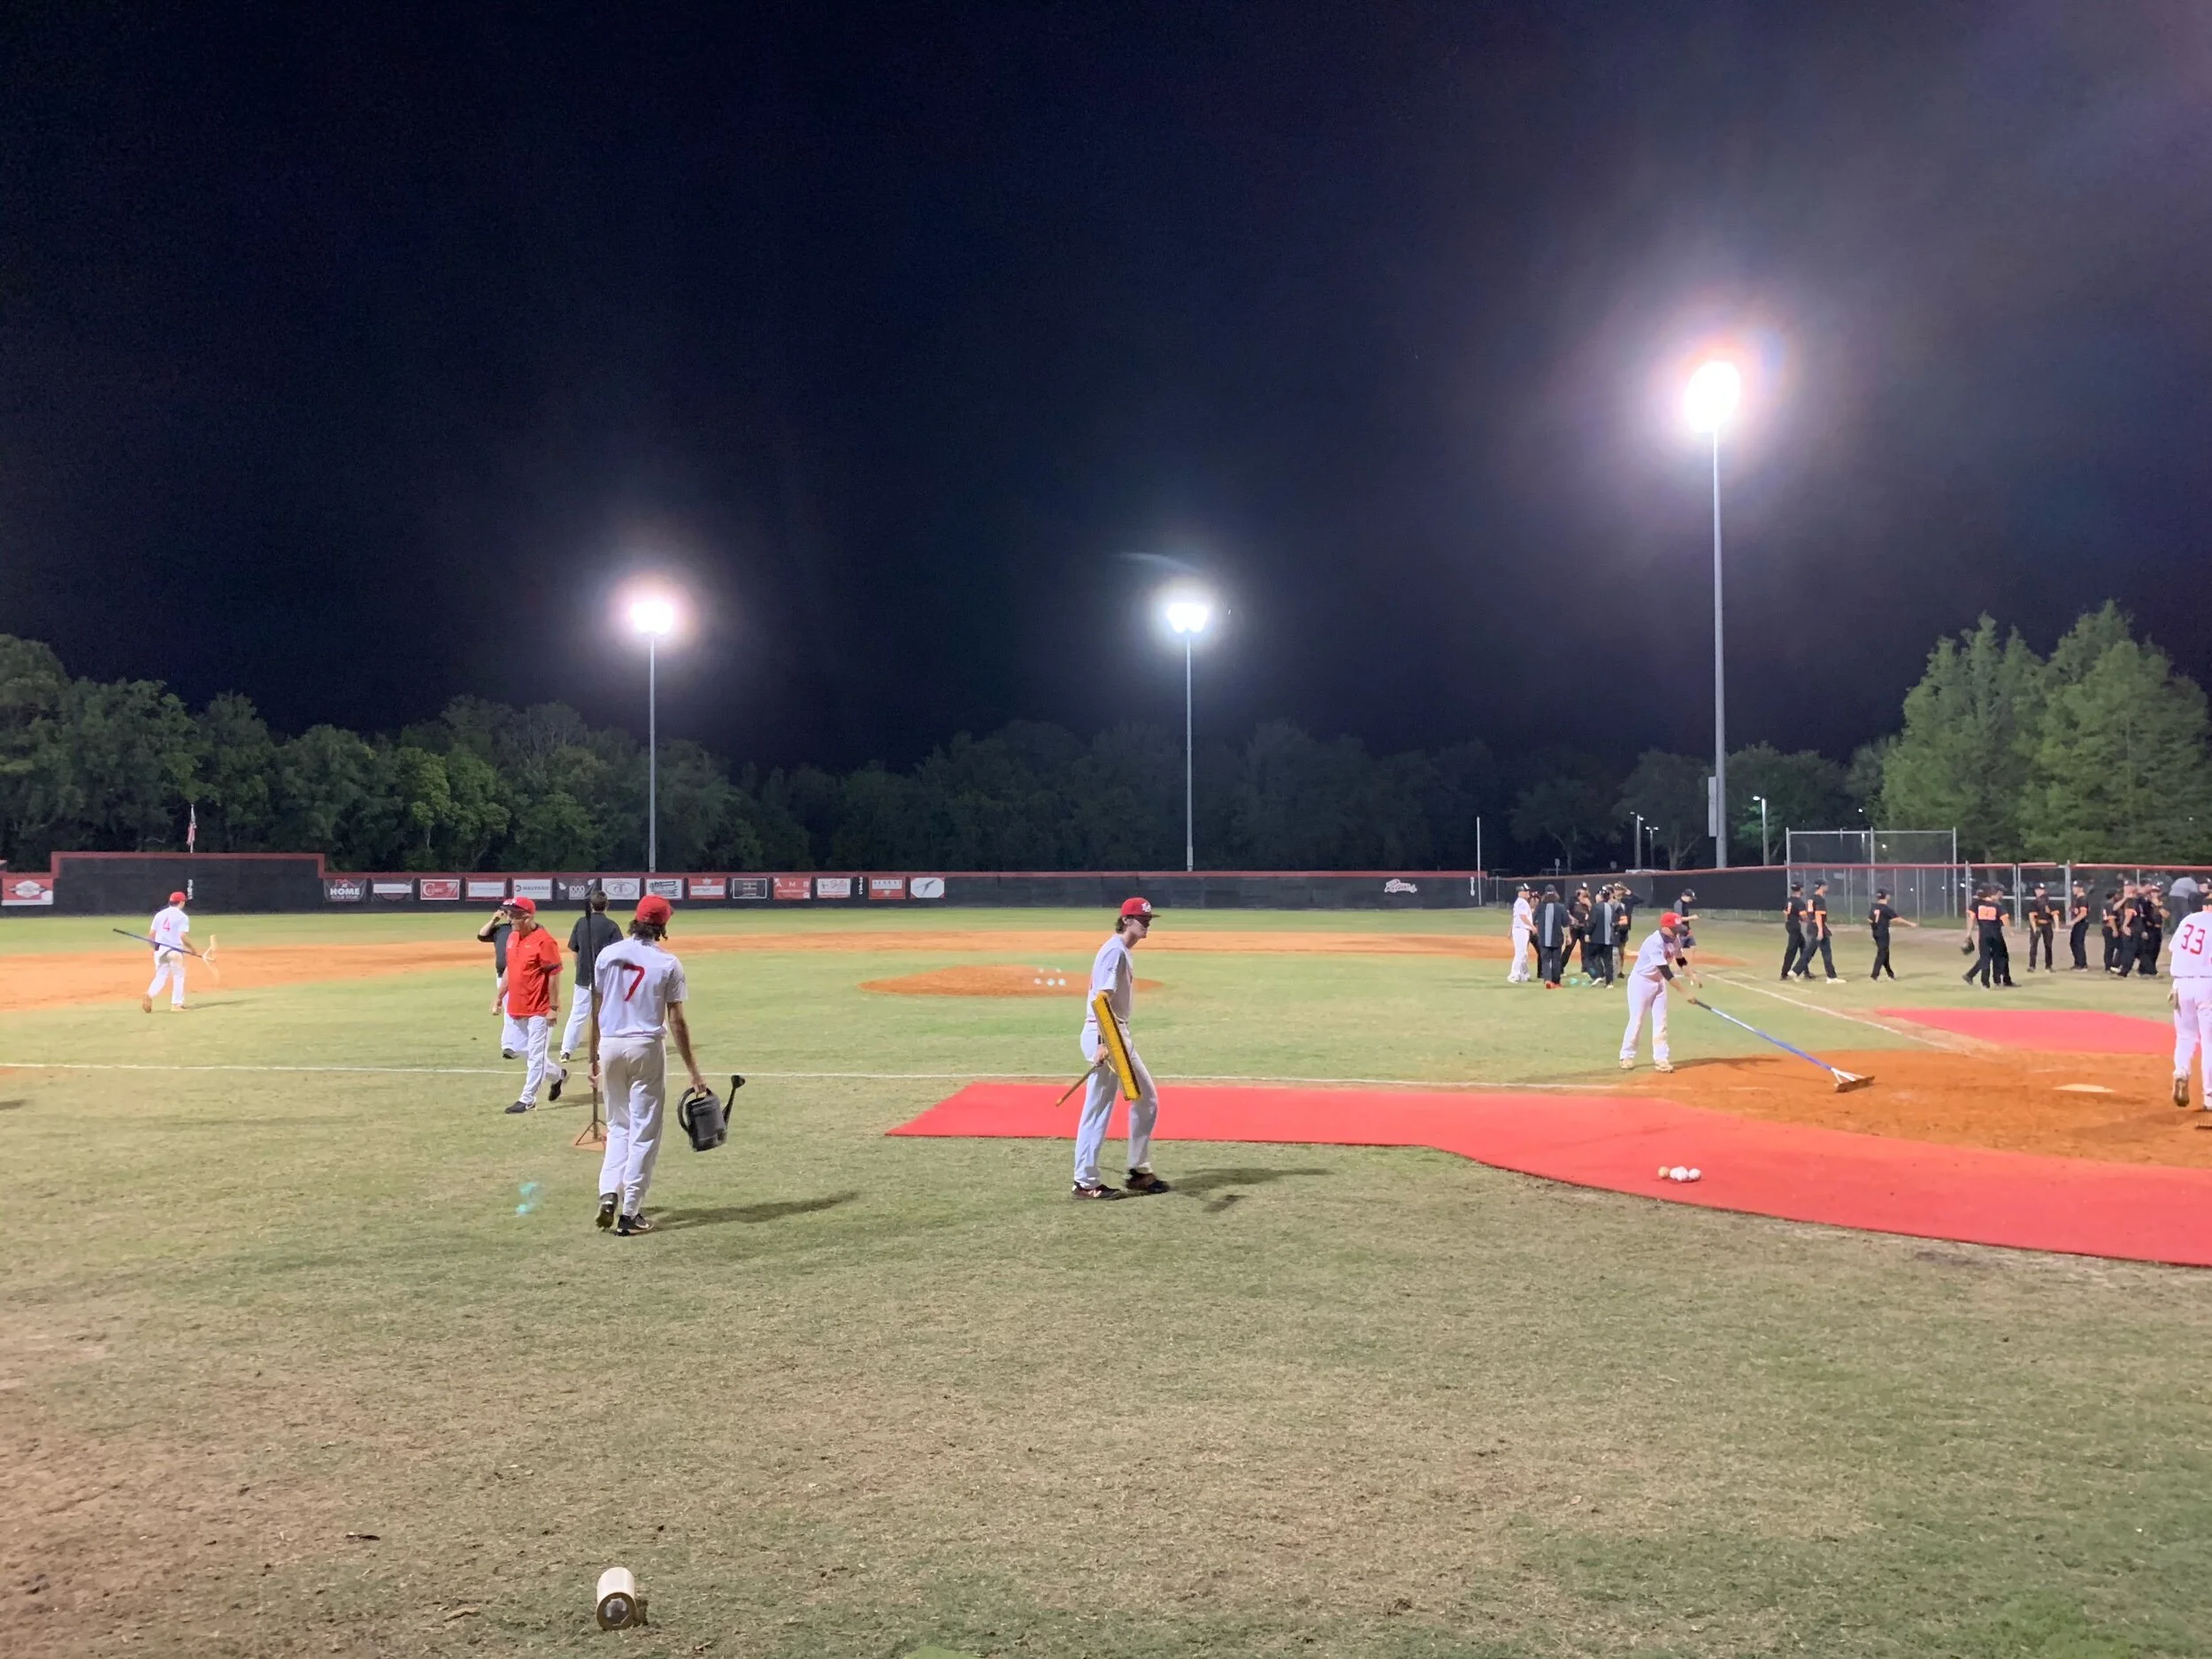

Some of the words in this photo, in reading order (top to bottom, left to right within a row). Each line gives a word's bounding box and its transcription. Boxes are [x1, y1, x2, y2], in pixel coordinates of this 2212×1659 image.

[163, 915, 171, 933] 4
[2180, 923, 2206, 956] 33
[622, 962, 646, 1002] 7
